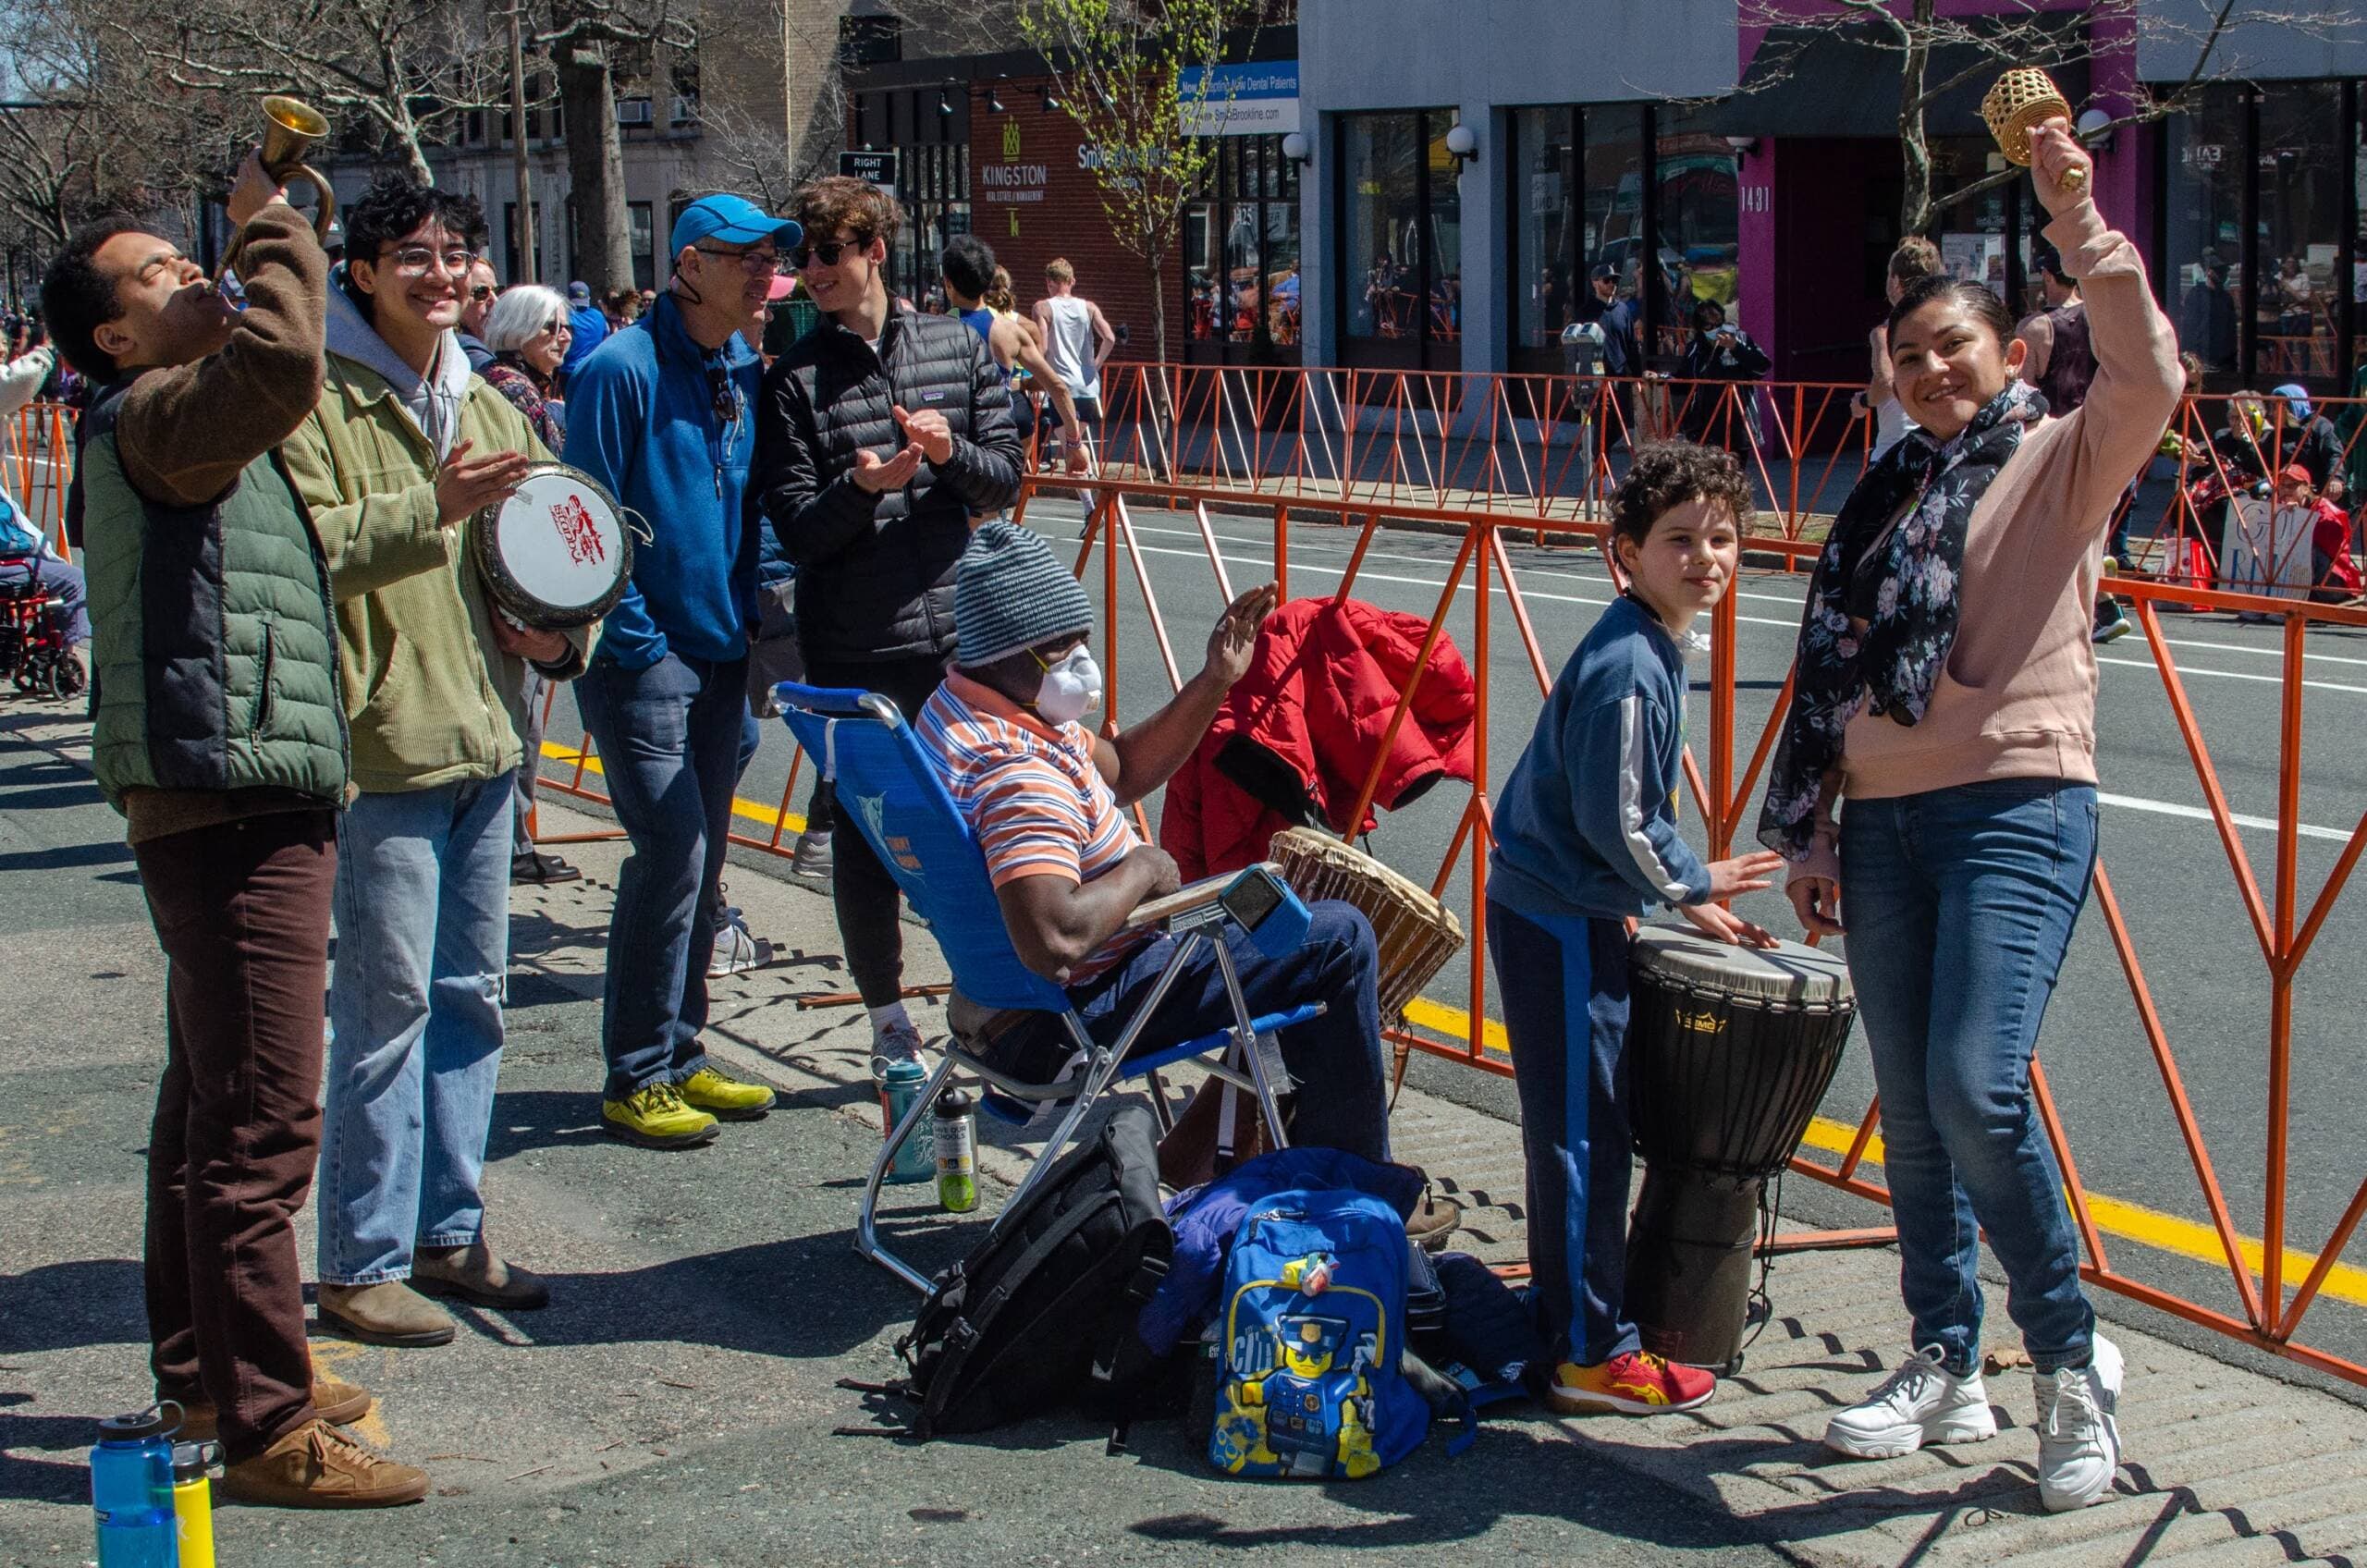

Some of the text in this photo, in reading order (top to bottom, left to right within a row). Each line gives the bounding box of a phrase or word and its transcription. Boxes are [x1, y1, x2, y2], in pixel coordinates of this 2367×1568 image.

[1247, 76, 1269, 90] Dental
[1270, 75, 1296, 89] Patients
[854, 157, 882, 167] RIGHT
[855, 170, 880, 180] LANE
[982, 165, 1047, 186] KINGSTON
[1741, 186, 1770, 213] 1431
